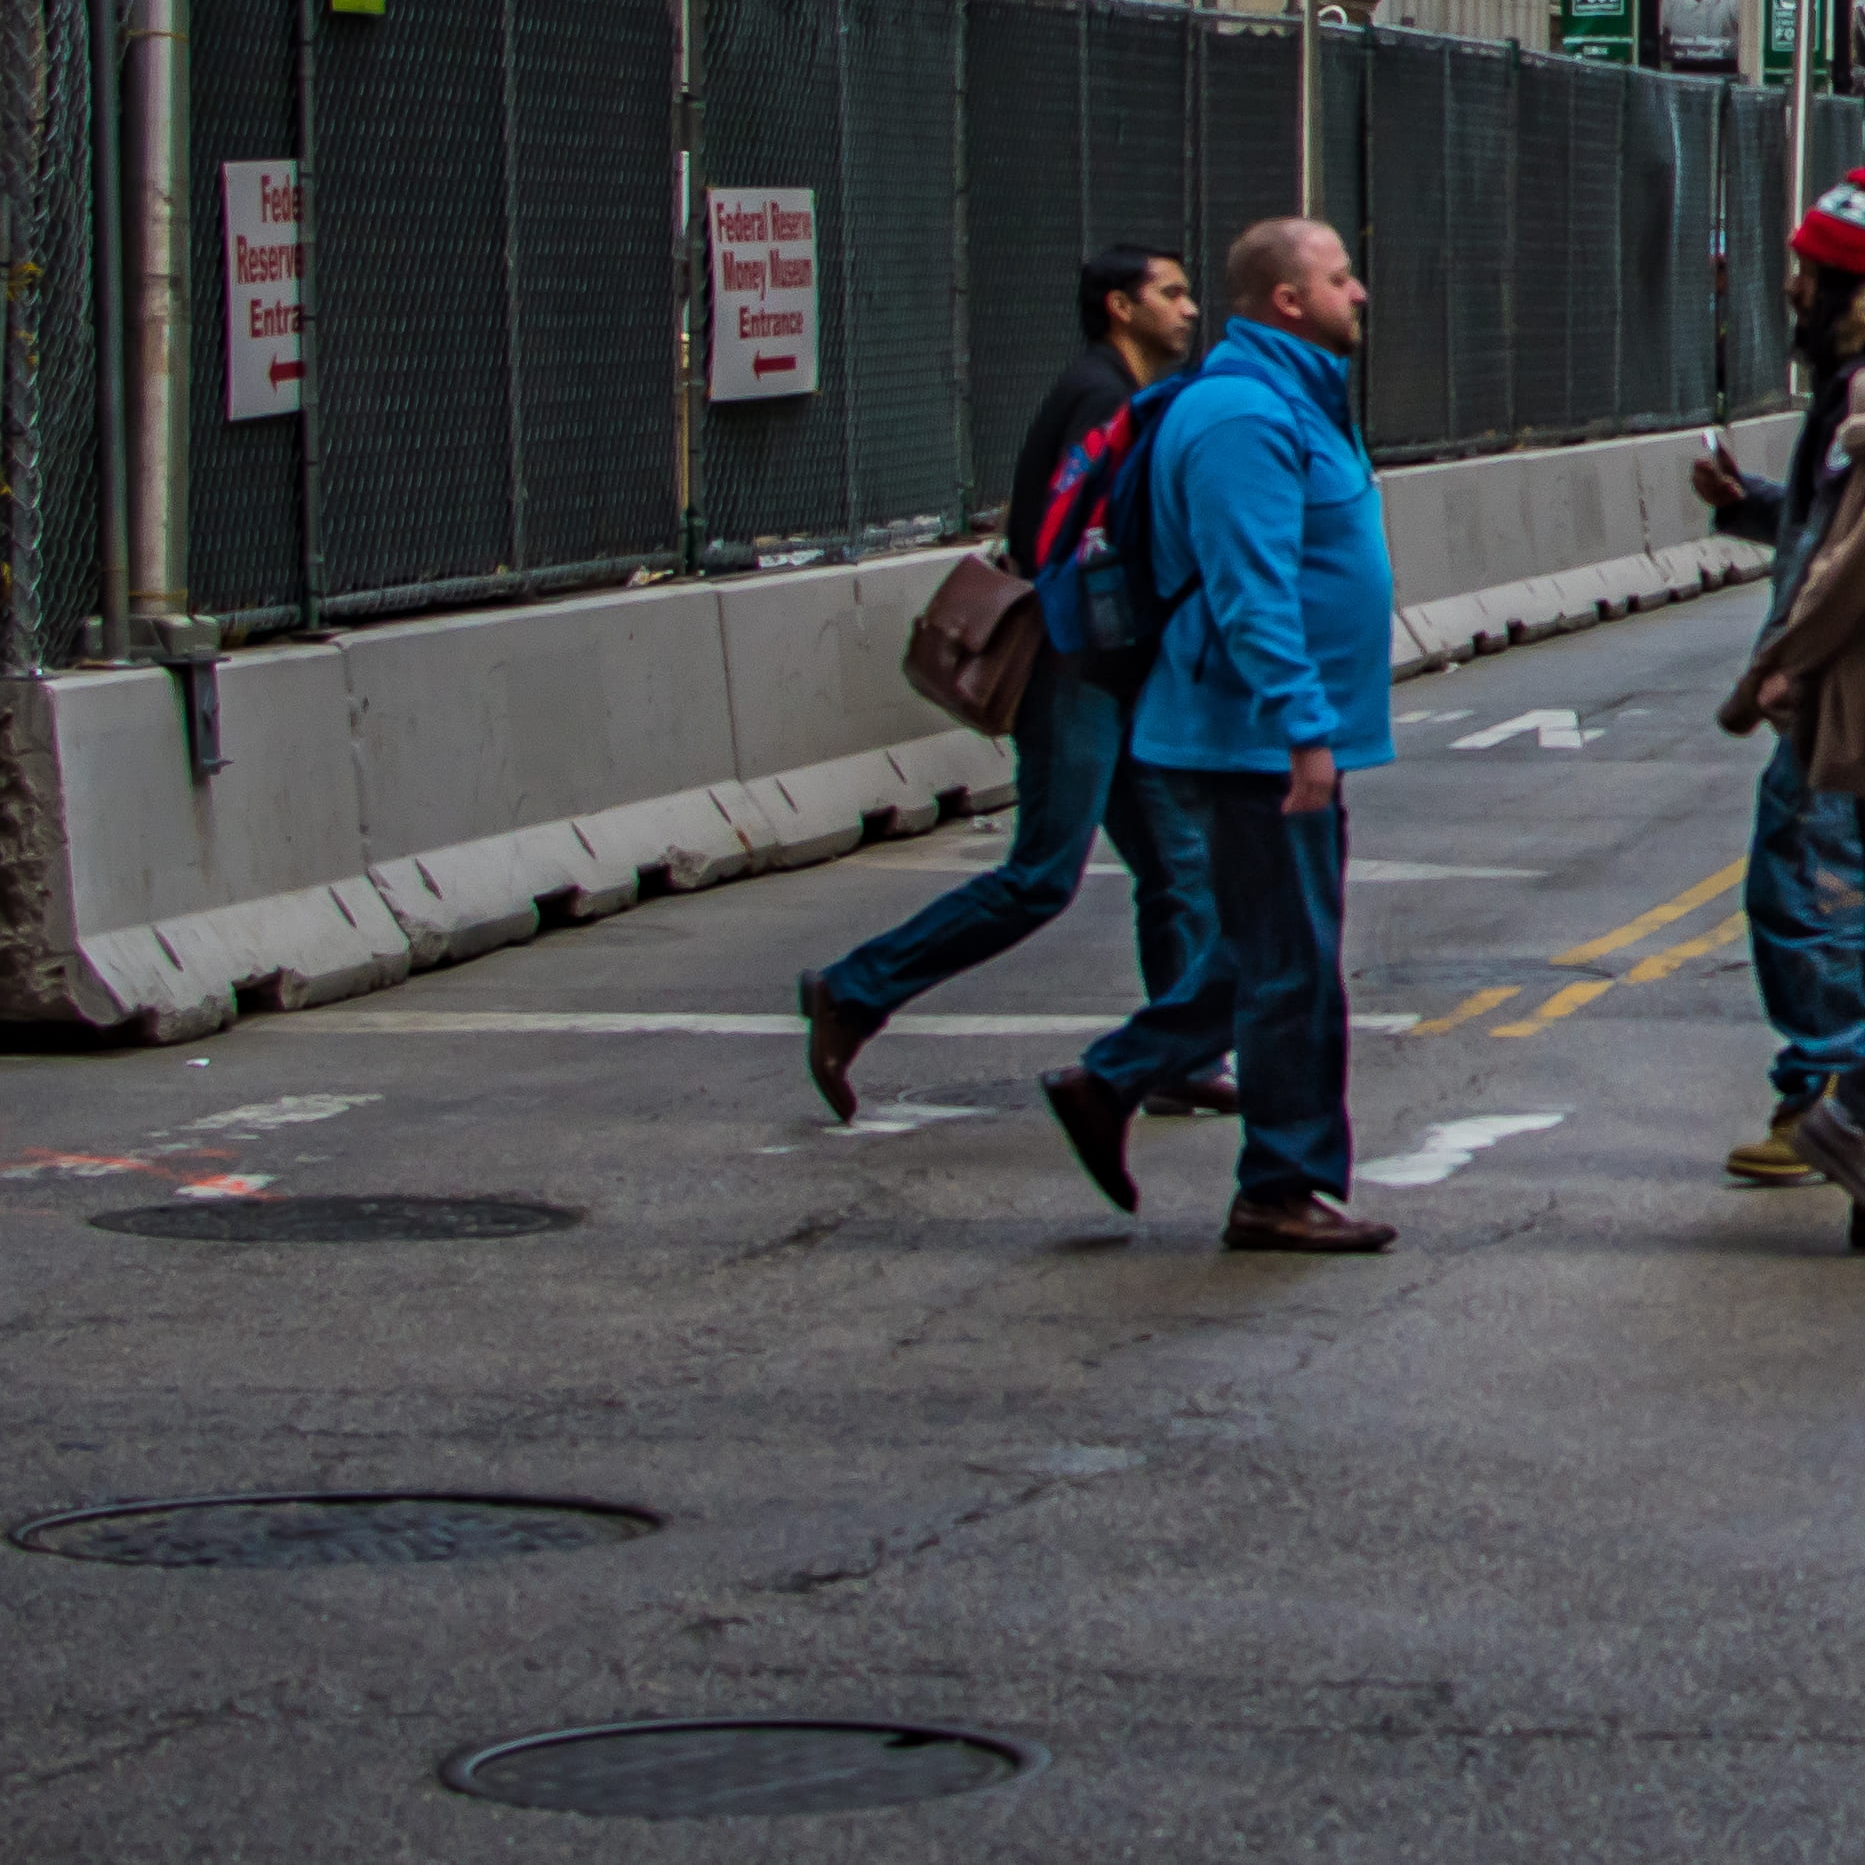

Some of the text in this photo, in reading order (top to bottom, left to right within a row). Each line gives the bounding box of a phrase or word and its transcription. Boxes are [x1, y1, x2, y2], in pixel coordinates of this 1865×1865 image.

[261, 174, 305, 224] Fede
[715, 200, 813, 244] Federal Reserve
[722, 248, 813, 301] Money Museum
[250, 299, 305, 339] Entra
[739, 306, 804, 340] Entrance
